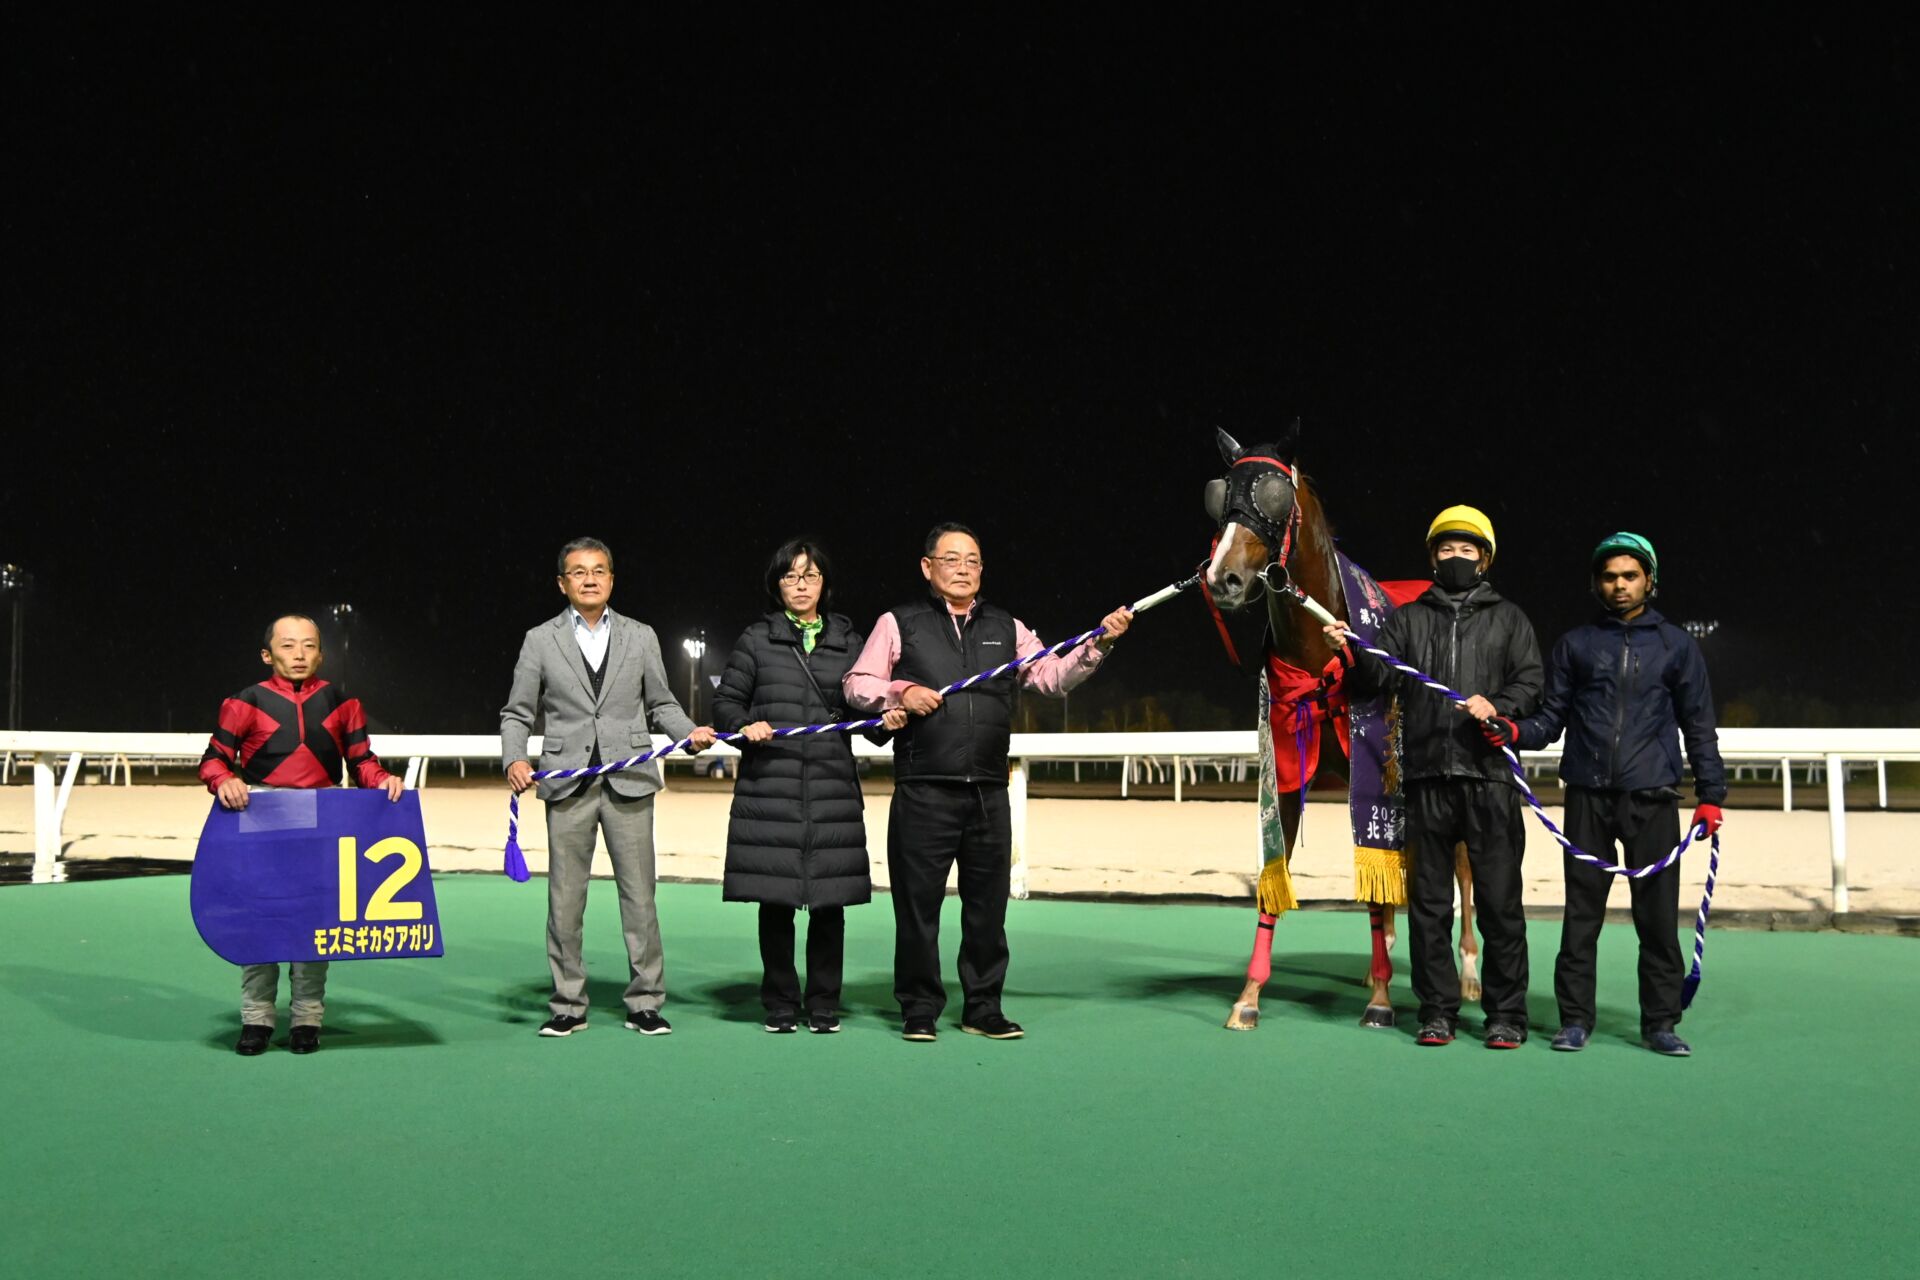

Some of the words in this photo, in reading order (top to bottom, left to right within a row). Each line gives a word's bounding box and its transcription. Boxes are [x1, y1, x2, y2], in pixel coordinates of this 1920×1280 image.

[338, 836, 423, 921] 12
[314, 923, 434, 955] モズミギカタアガリ
